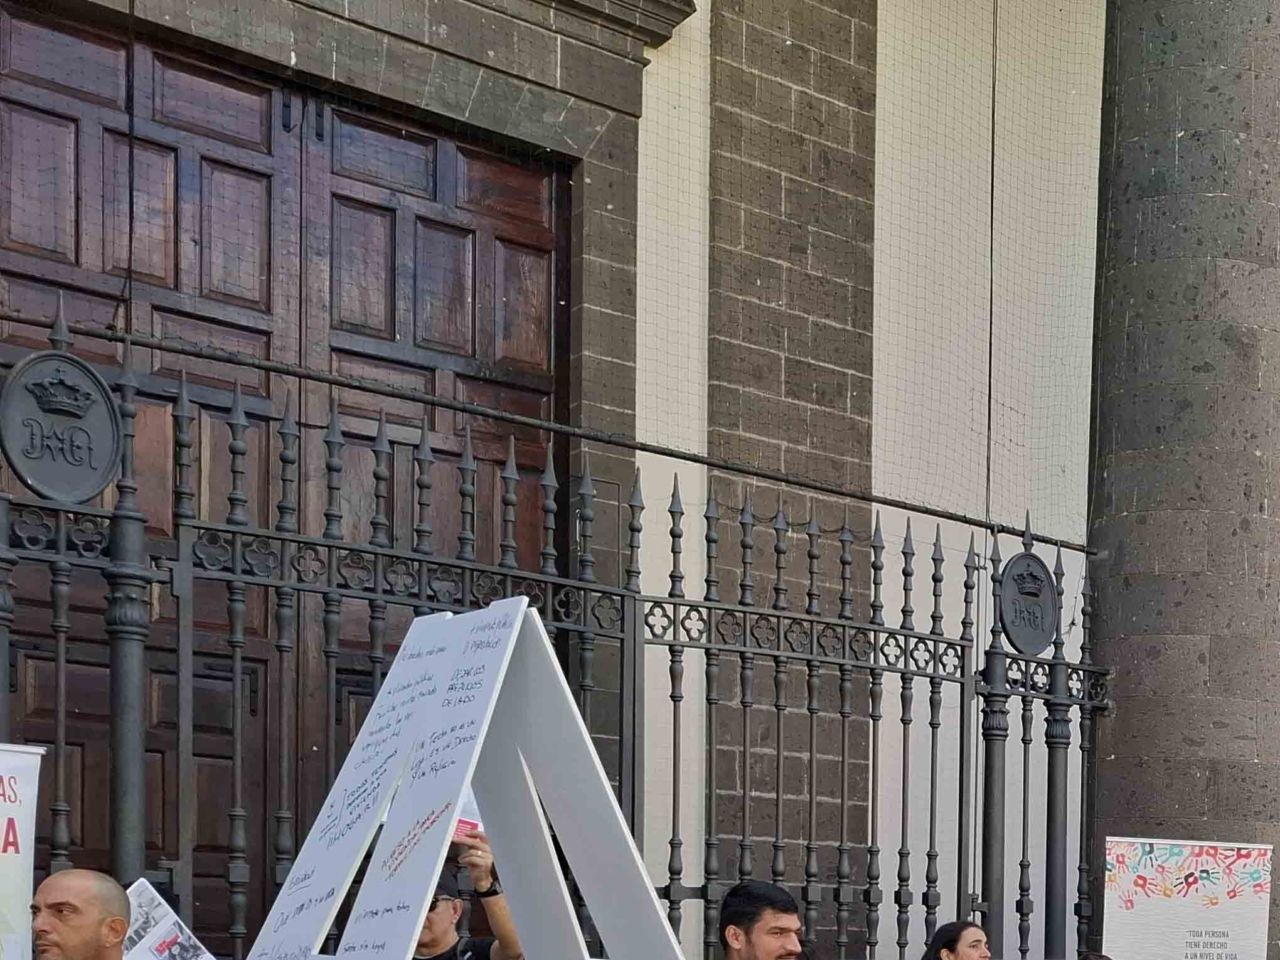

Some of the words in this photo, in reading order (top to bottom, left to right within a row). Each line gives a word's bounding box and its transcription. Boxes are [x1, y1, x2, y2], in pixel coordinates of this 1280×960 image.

[1204, 930, 1230, 938] PERSONA
[1185, 941, 1201, 949] TIENE
[1224, 953, 1238, 960] VIDA
